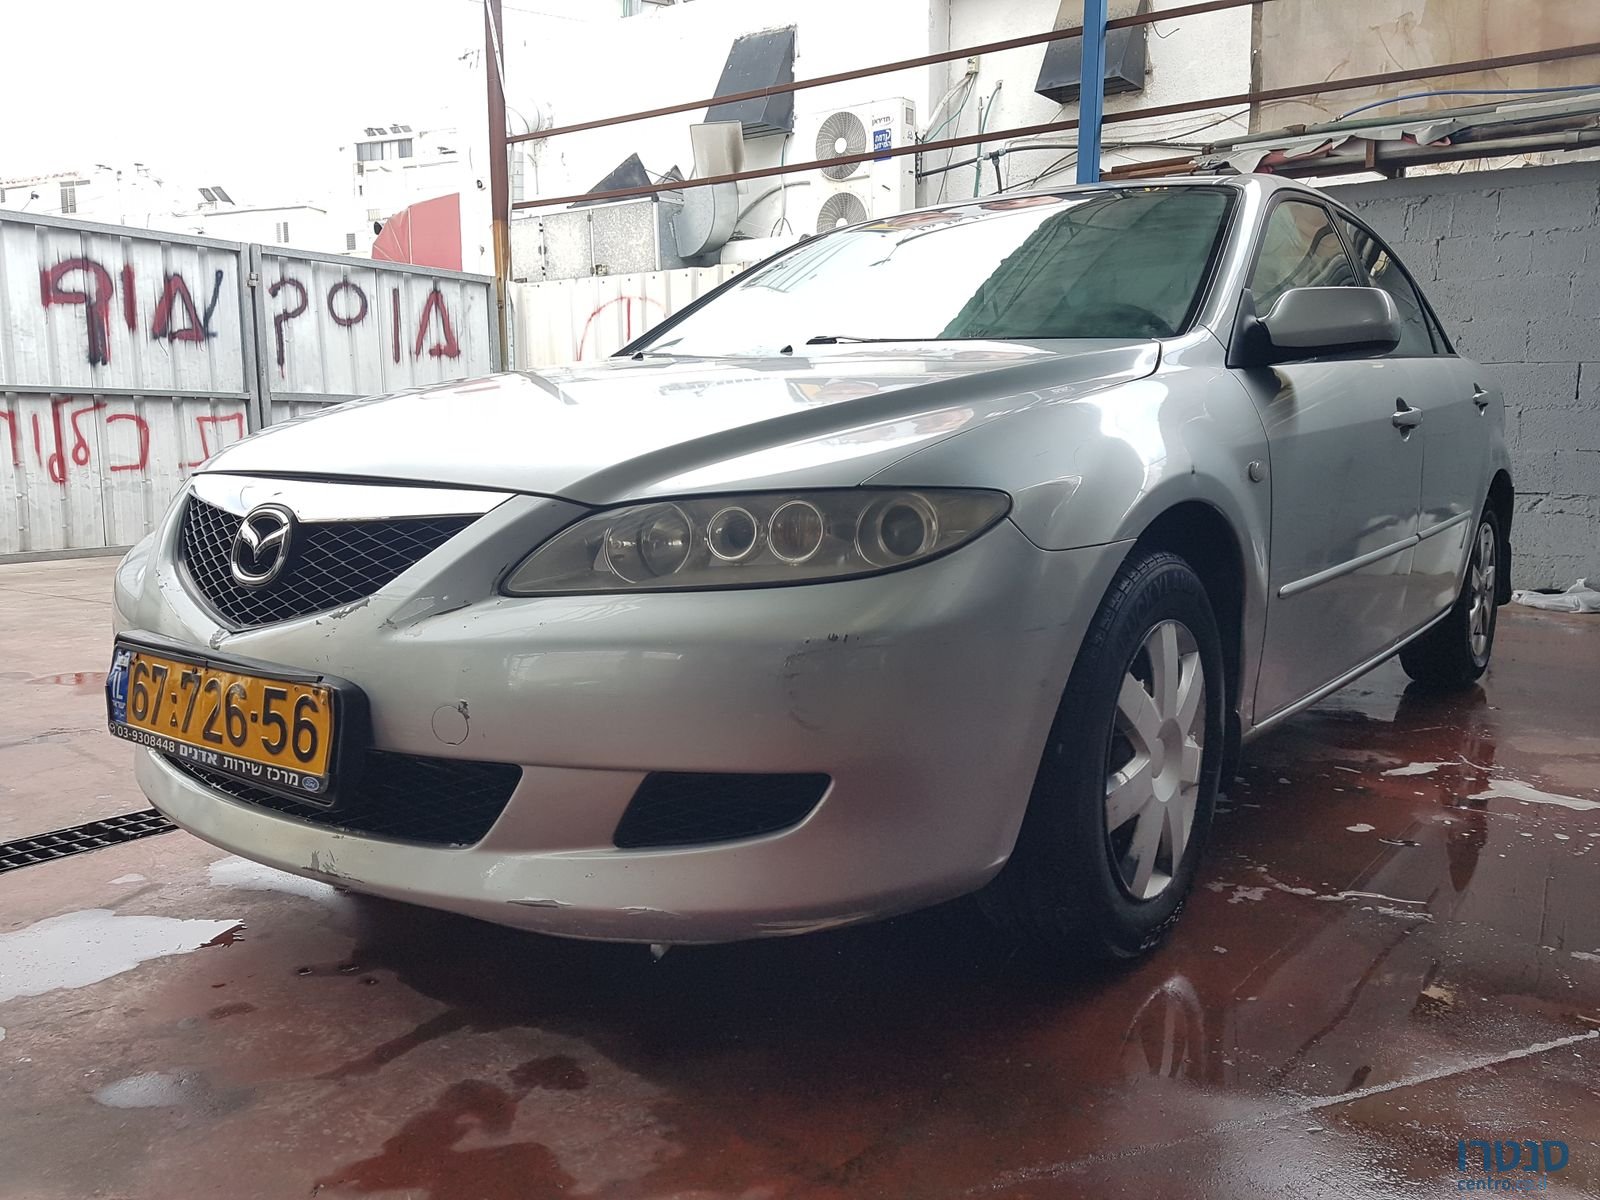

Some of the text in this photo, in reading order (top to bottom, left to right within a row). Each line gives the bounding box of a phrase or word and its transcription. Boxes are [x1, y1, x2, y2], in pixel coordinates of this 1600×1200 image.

[117, 726, 175, 752] 03-9308448
[223, 755, 261, 776] שירות
[266, 766, 298, 787] מרכז
